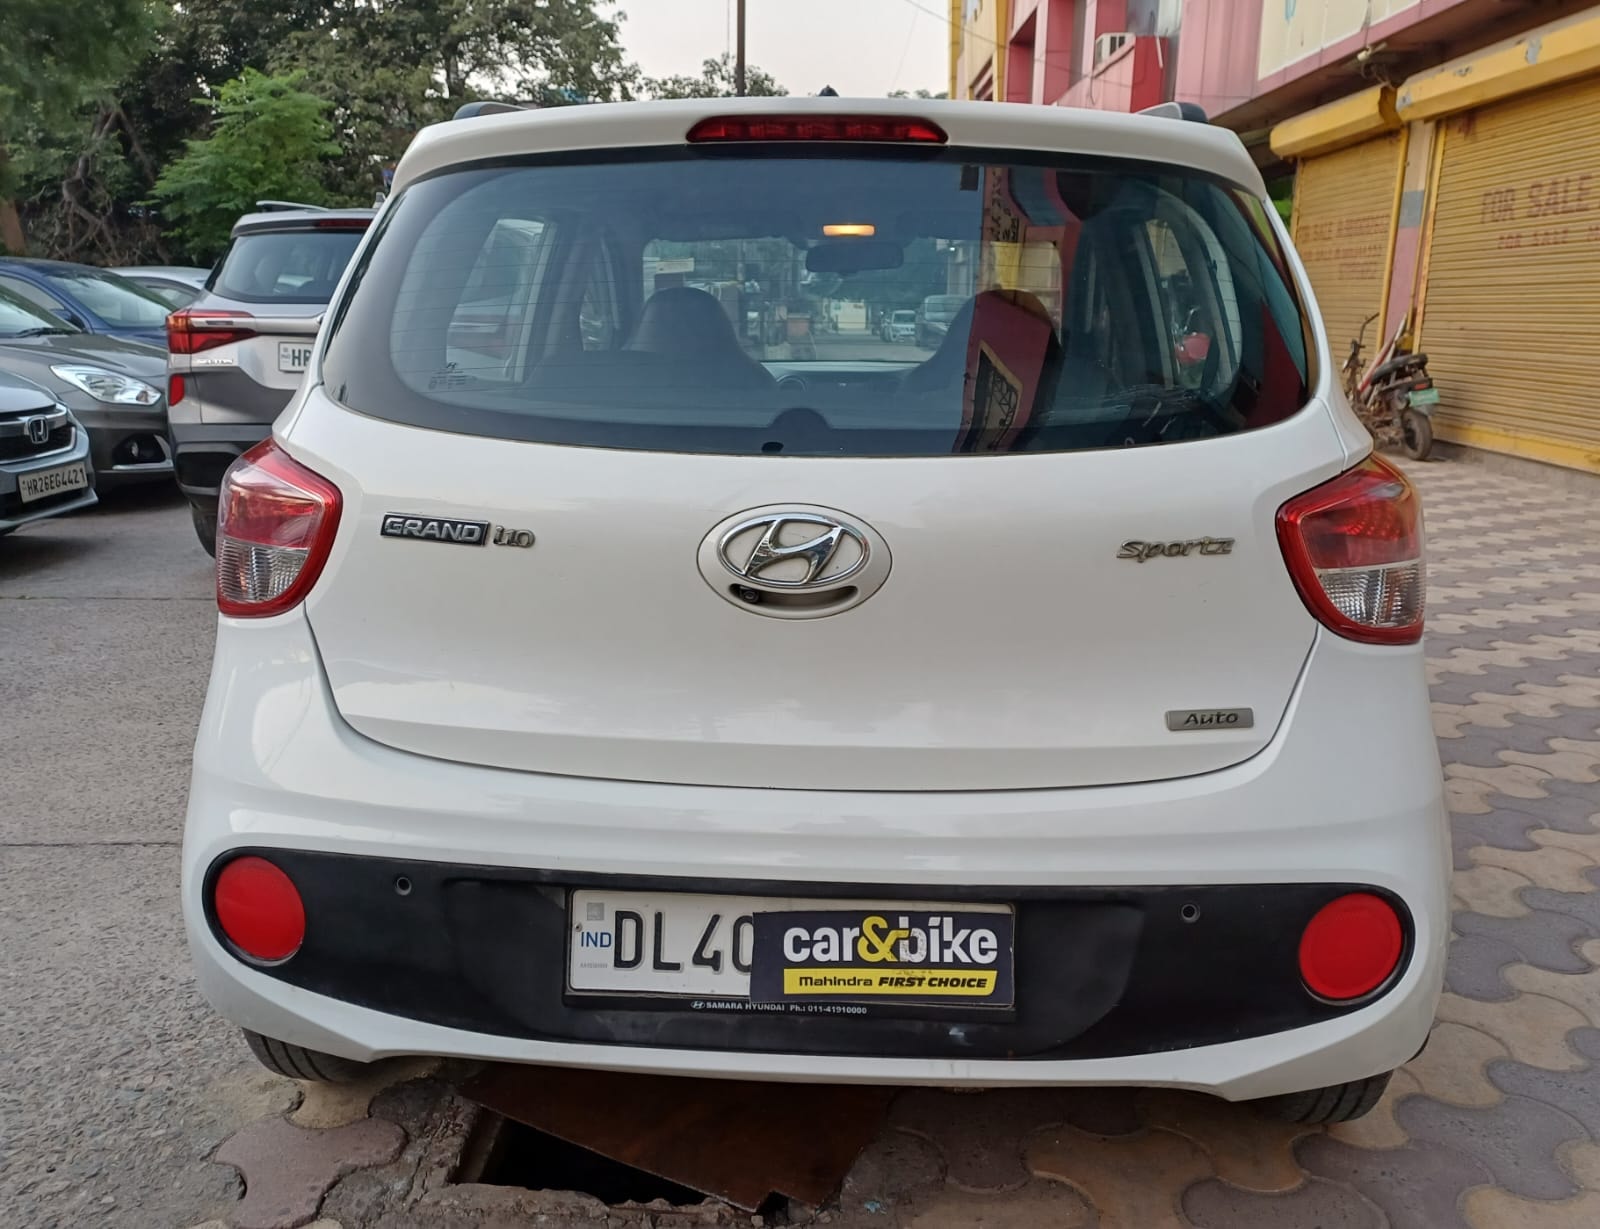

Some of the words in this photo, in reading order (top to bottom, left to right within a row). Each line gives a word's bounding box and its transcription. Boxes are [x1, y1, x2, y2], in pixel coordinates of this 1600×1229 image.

[1480, 188, 1515, 224] FOR
[1527, 174, 1593, 218] SALE
[26, 467, 86, 496] HR26EG4421
[384, 516, 481, 543] GRAND
[1116, 536, 1235, 563] Sportz
[1184, 711, 1238, 725] Auto
[581, 931, 612, 948] IND
[783, 915, 998, 964] car&bike
[799, 975, 873, 987] Mahindra
[878, 976, 926, 988] FIRST
[927, 977, 987, 989] CHOICE
[706, 1001, 743, 1010] SAMARA
[745, 1002, 785, 1012] HYUNDAI
